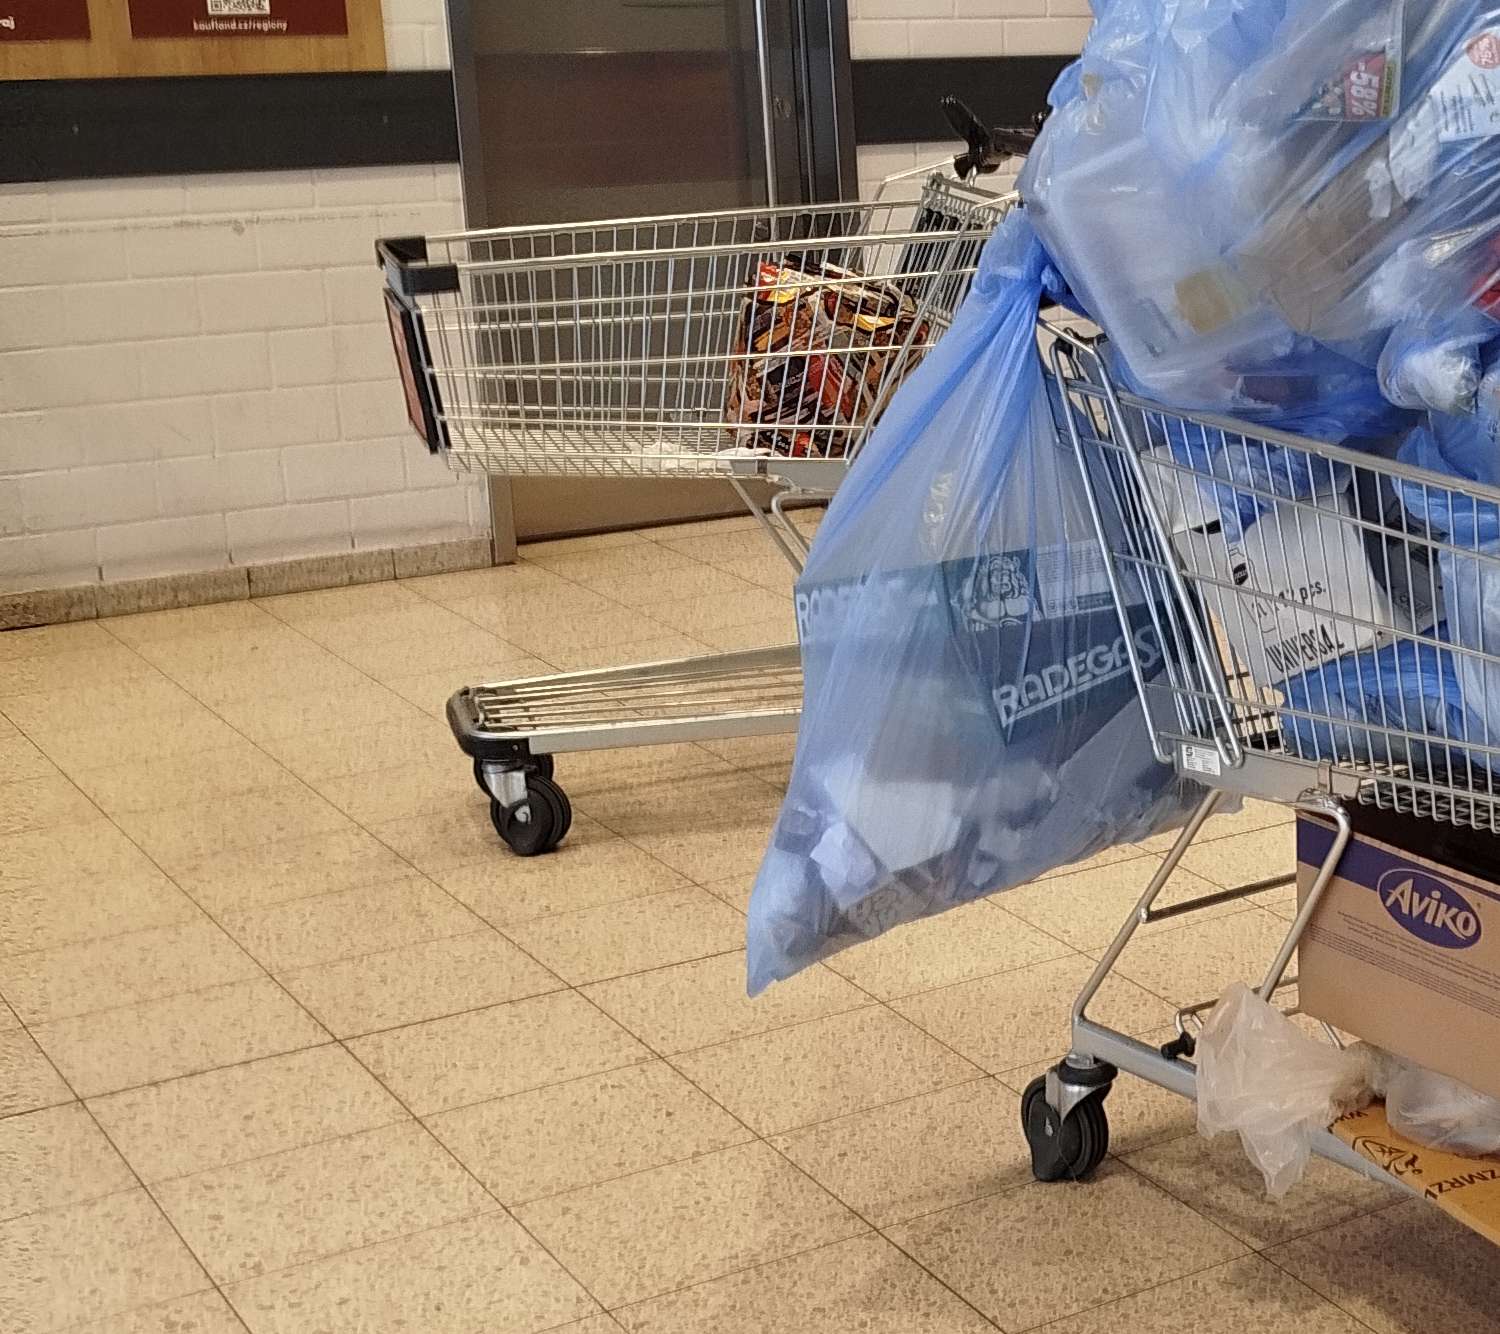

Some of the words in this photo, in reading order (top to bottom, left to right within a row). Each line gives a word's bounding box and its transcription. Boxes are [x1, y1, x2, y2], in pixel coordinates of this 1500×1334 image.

[193, 18, 288, 32] kaufland.cz/regiony
[1265, 623, 1345, 674] UNIVERSAL
[1386, 878, 1478, 940] Aviko
